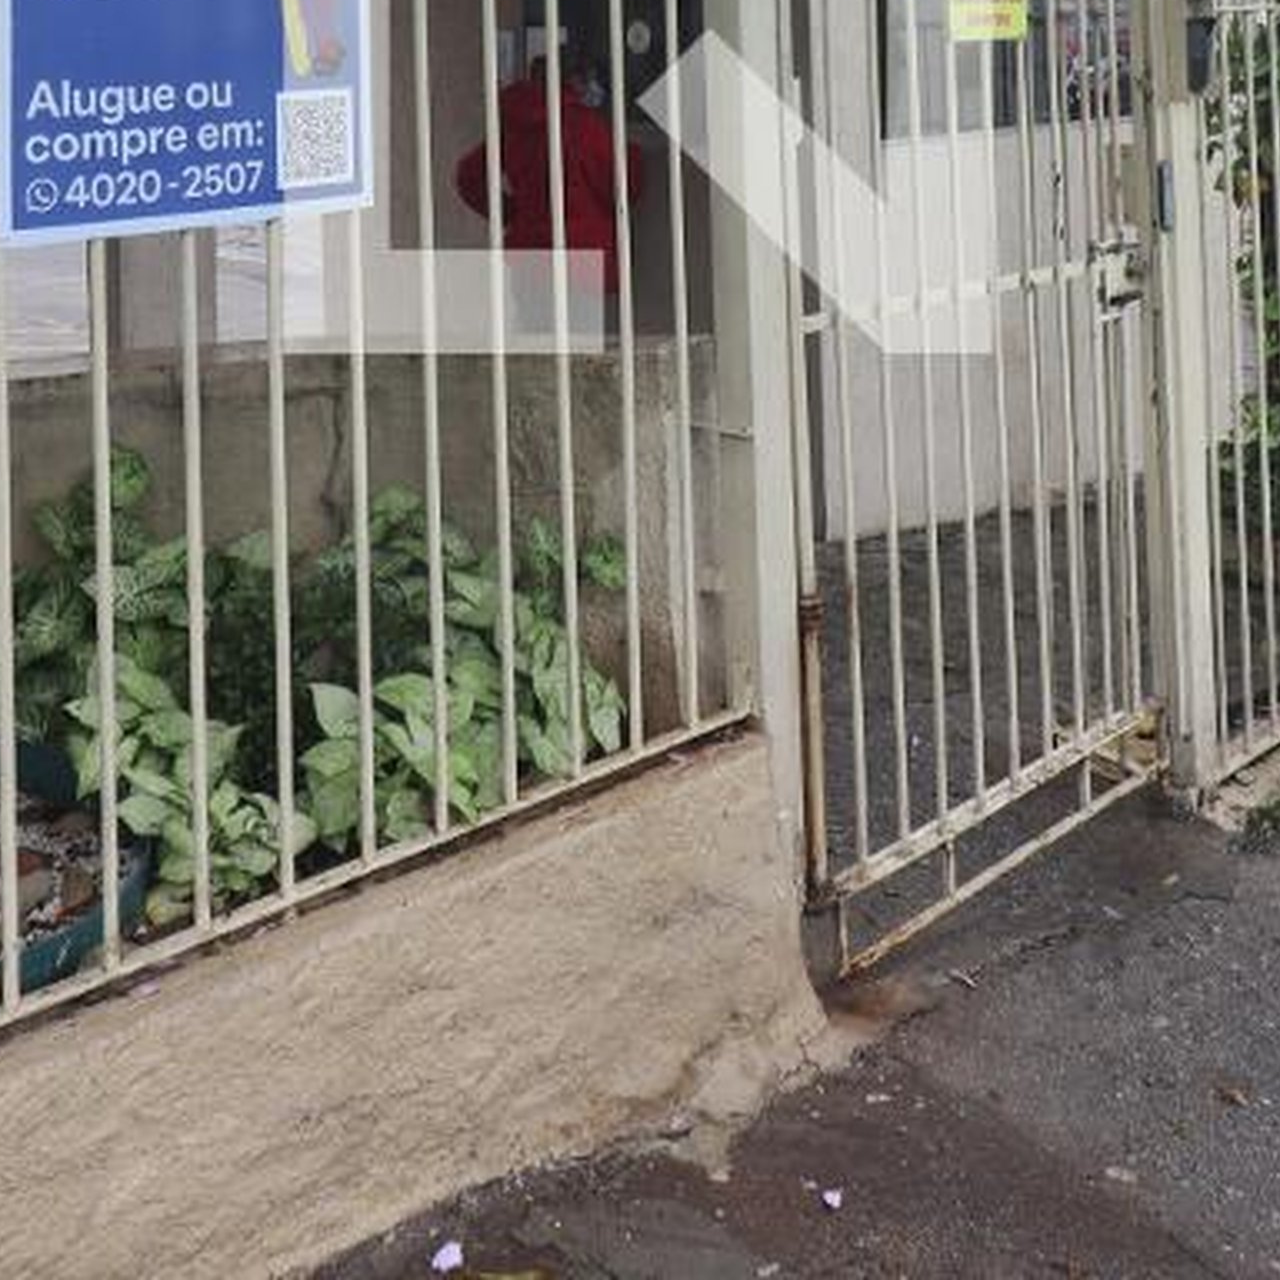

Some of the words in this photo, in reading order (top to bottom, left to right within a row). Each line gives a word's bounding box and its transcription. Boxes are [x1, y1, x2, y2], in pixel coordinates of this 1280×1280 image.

[26, 80, 175, 125] Alugue
[185, 80, 233, 110] ou
[25, 124, 188, 166] compre
[197, 120, 264, 150] em:
